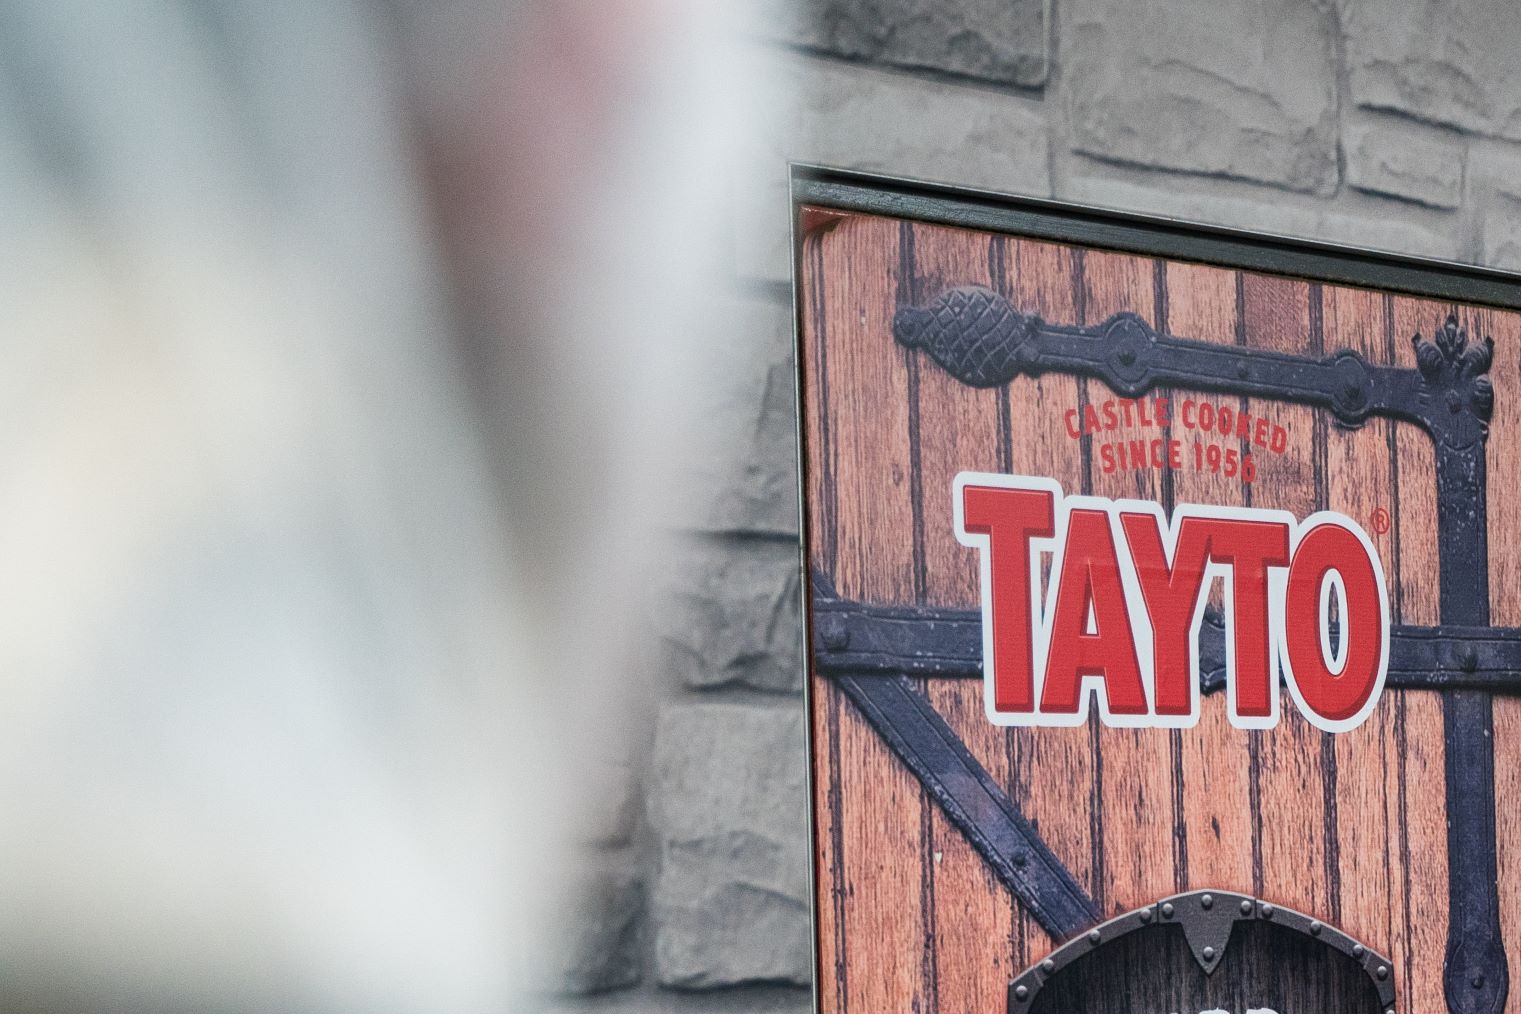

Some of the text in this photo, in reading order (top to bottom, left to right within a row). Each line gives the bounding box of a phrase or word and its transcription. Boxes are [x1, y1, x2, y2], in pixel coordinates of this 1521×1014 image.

[1064, 398, 1288, 455] CASTLE COOKED
[1100, 438, 1257, 483] SINCE 1956
[958, 478, 1386, 727] TAYTO
